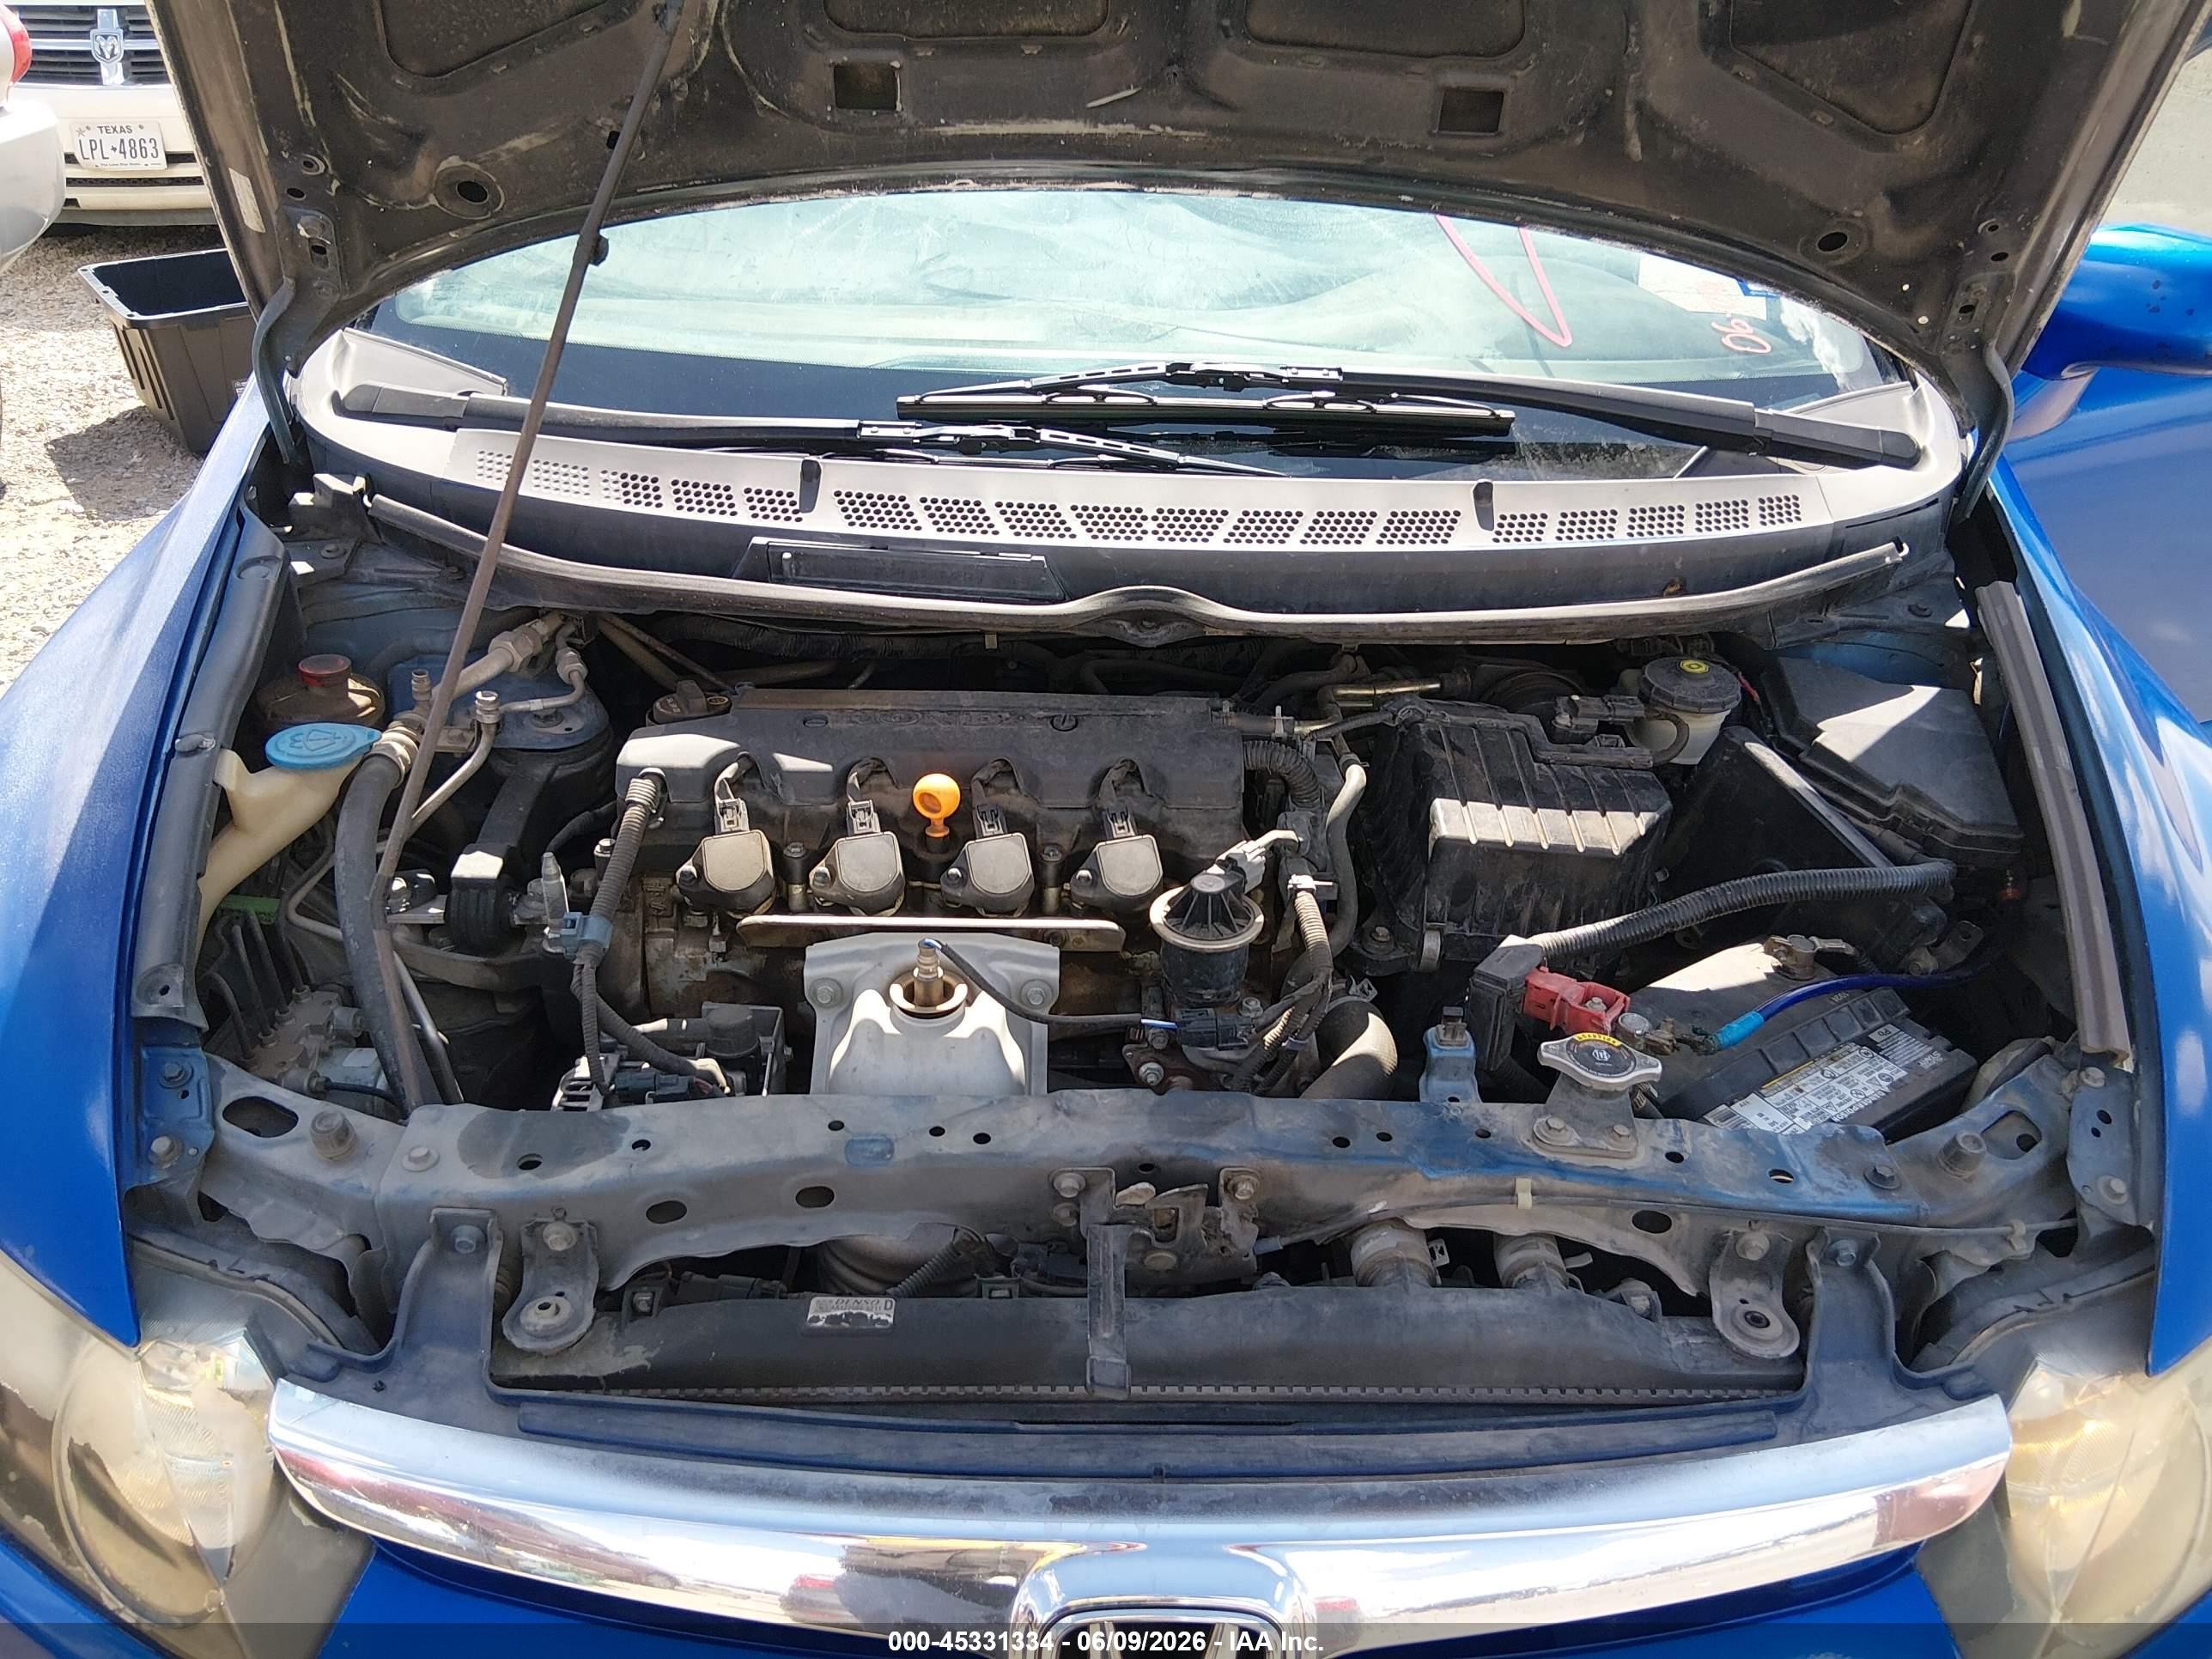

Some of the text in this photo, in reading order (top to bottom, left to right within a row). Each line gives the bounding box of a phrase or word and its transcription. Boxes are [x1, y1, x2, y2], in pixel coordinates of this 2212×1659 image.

[97, 125, 132, 134] TEXAS
[79, 137, 159, 160] LPL 4863
